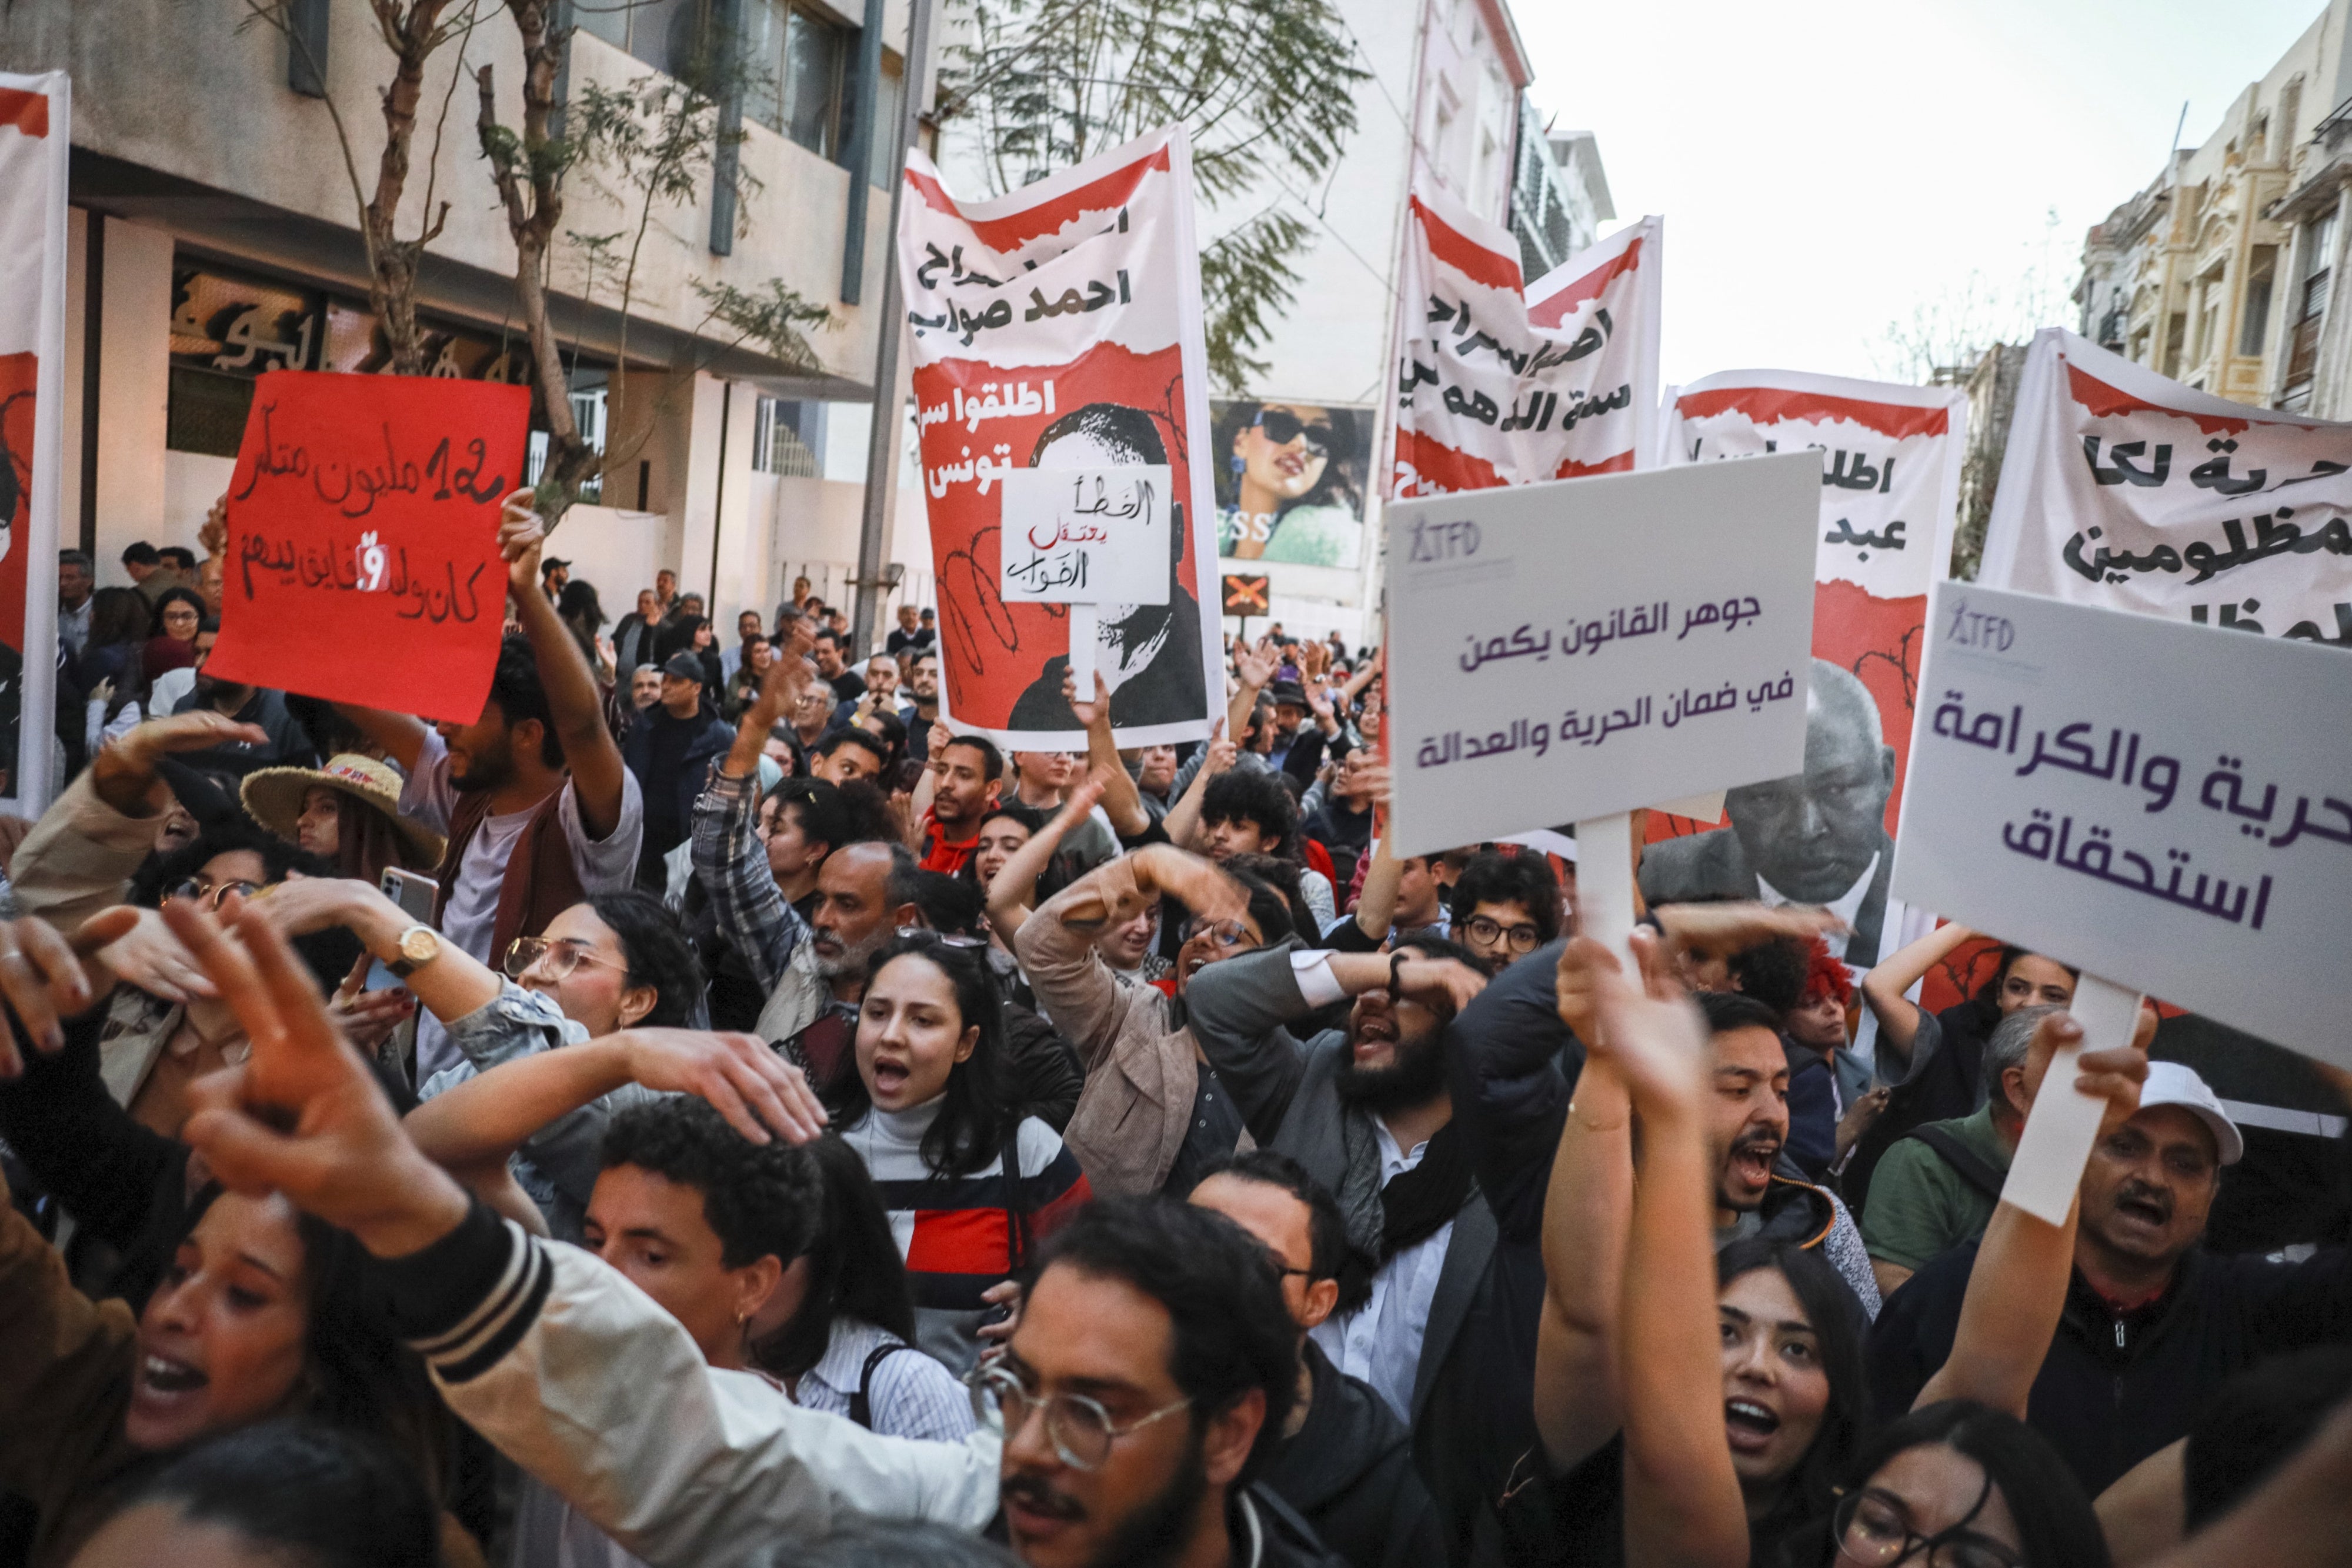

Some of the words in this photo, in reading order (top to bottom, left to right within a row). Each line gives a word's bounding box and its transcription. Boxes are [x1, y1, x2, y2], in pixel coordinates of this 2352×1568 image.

[1025, 269, 1131, 322] احمد
[909, 296, 1012, 347] صواب
[953, 379, 1056, 434] اطلقوا
[314, 422, 419, 517] مليون
[426, 437, 505, 503] 12
[929, 443, 1013, 499] تونس
[1028, 513, 1107, 550] يعتقل
[1824, 518, 1906, 562] عبد
[1562, 601, 1669, 656] القانون
[1677, 595, 1762, 640] جوهر
[1459, 623, 1552, 672] يكمن
[1662, 682, 1738, 728] ضمان
[1746, 670, 1794, 713] في
[1417, 718, 1549, 769] والعدالة
[1559, 696, 1652, 745] الحرية
[1932, 689, 2181, 813] والكرامة
[2002, 808, 2273, 931] استحقاق
